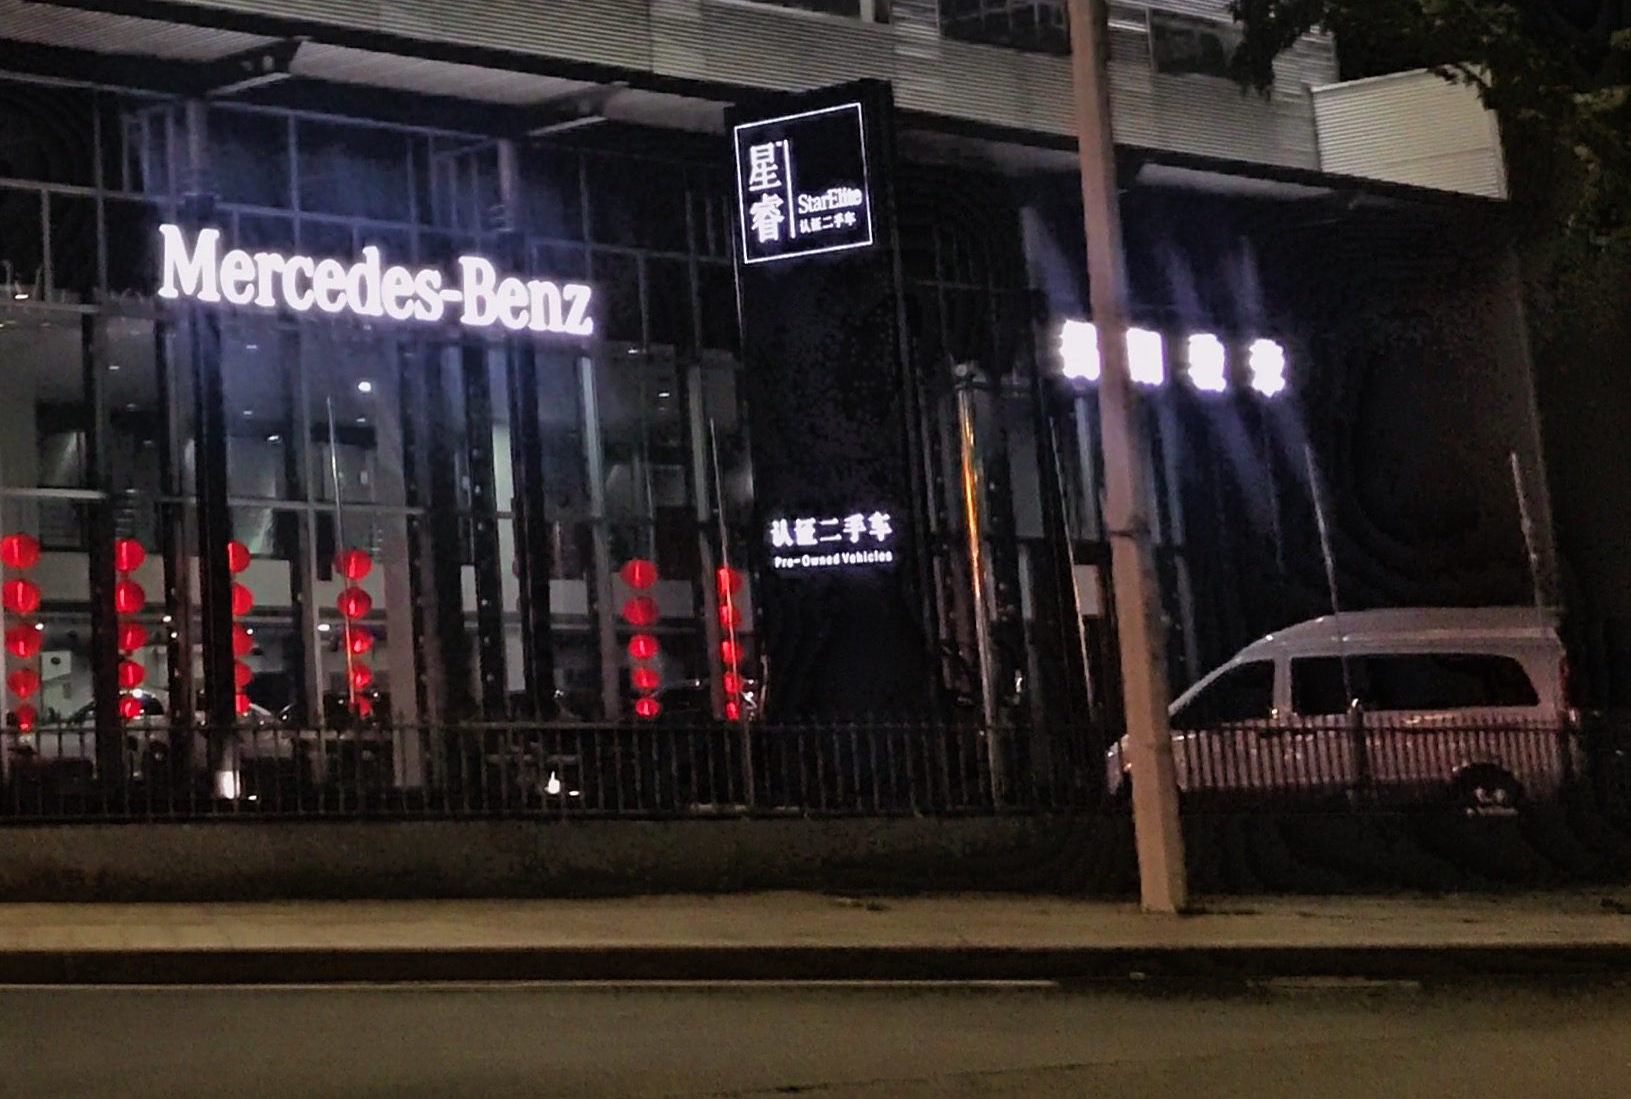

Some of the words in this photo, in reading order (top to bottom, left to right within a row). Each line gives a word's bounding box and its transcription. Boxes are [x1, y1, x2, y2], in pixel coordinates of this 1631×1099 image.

[749, 142, 784, 243] 星睿
[797, 186, 863, 215] StarElite
[158, 223, 595, 337] Mercedes-Benz
[770, 511, 893, 548] 认证二手车
[774, 554, 840, 568] Pre-Owned
[841, 550, 893, 564] Vehicles
